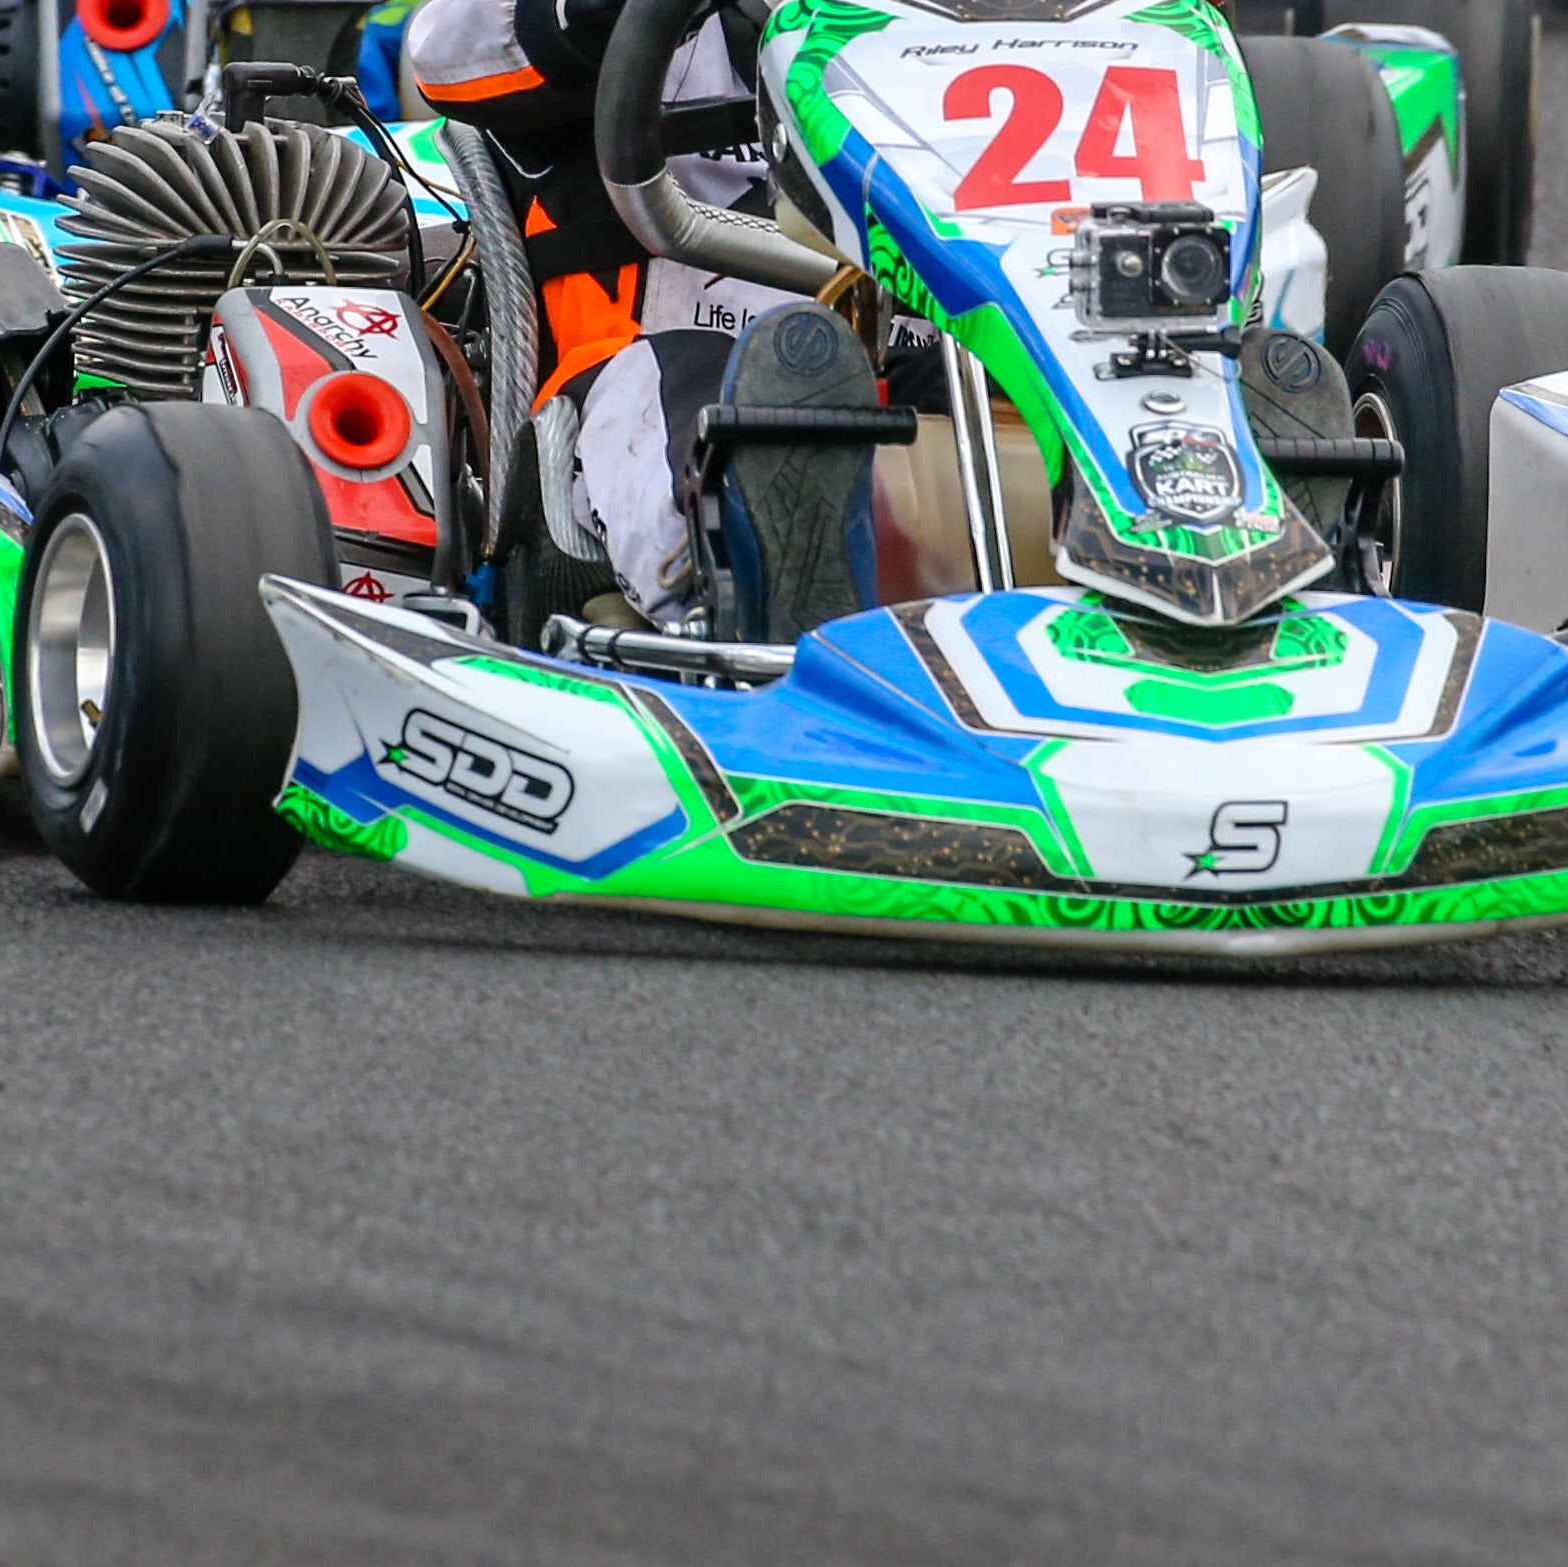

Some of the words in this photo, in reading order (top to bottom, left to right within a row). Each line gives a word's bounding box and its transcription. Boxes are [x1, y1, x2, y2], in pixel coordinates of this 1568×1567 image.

[899, 42, 981, 59] Riley
[990, 37, 1141, 52] Harrison
[942, 63, 1206, 213] 24
[282, 296, 379, 360] Anarchy
[693, 301, 736, 329] Life
[1155, 477, 1230, 496] KART
[399, 707, 575, 822] SDD
